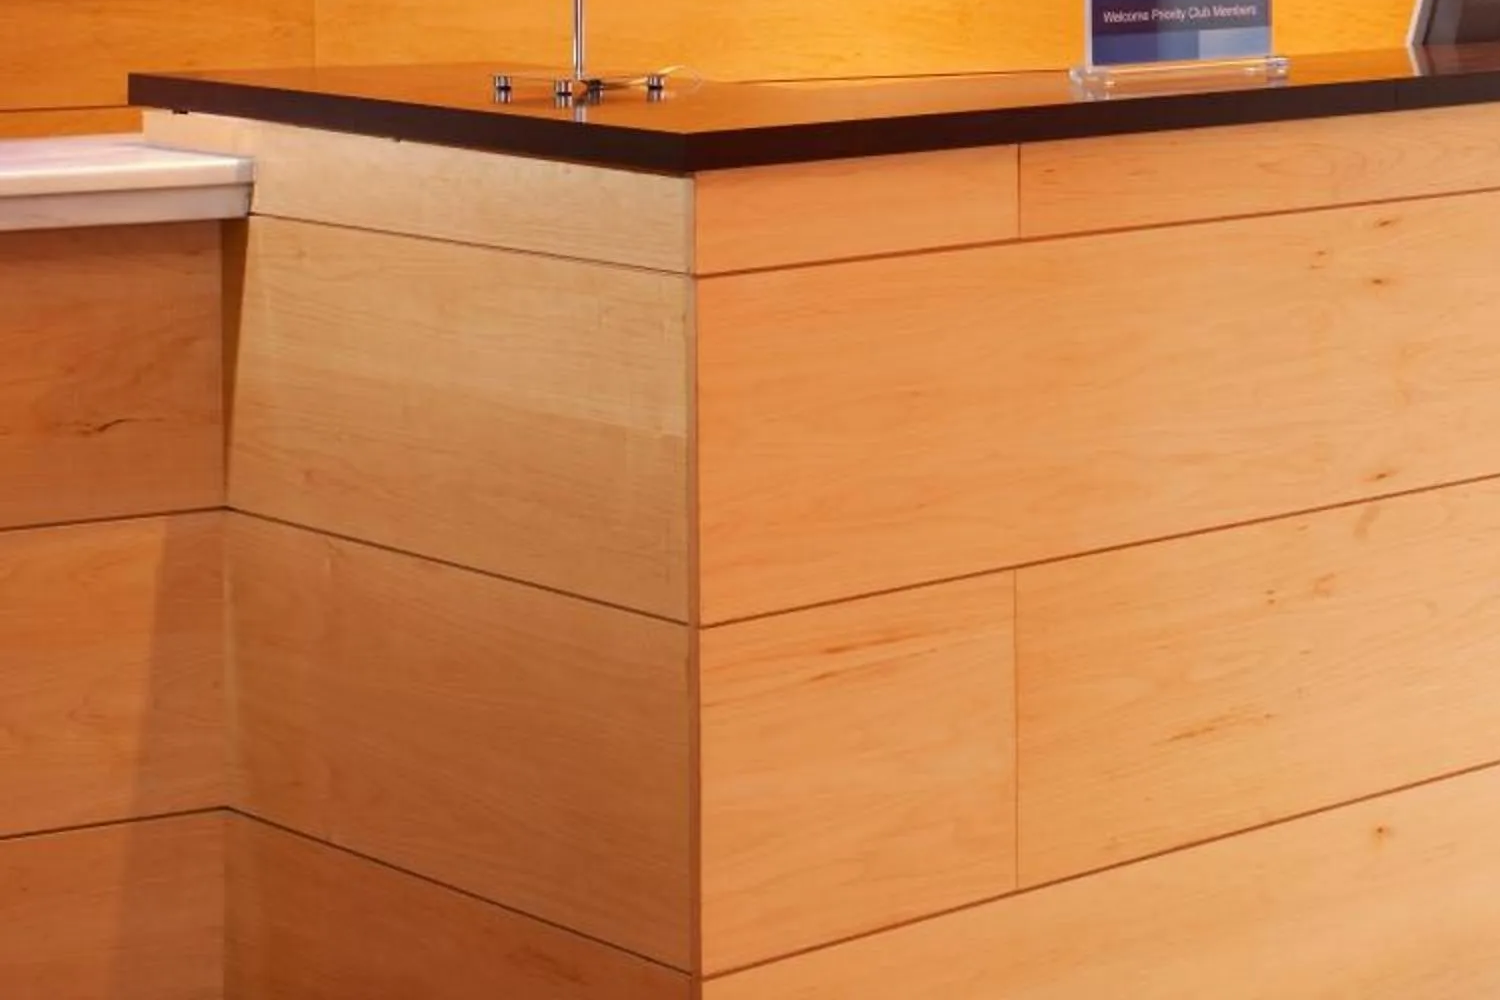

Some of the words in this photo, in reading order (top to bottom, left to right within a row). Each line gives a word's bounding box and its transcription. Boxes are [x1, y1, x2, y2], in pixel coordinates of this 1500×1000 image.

[1103, 10, 1149, 24] Welcome
[1151, 8, 1186, 22] Priority
[1188, 6, 1211, 20] Club
[1213, 4, 1257, 18] Members
